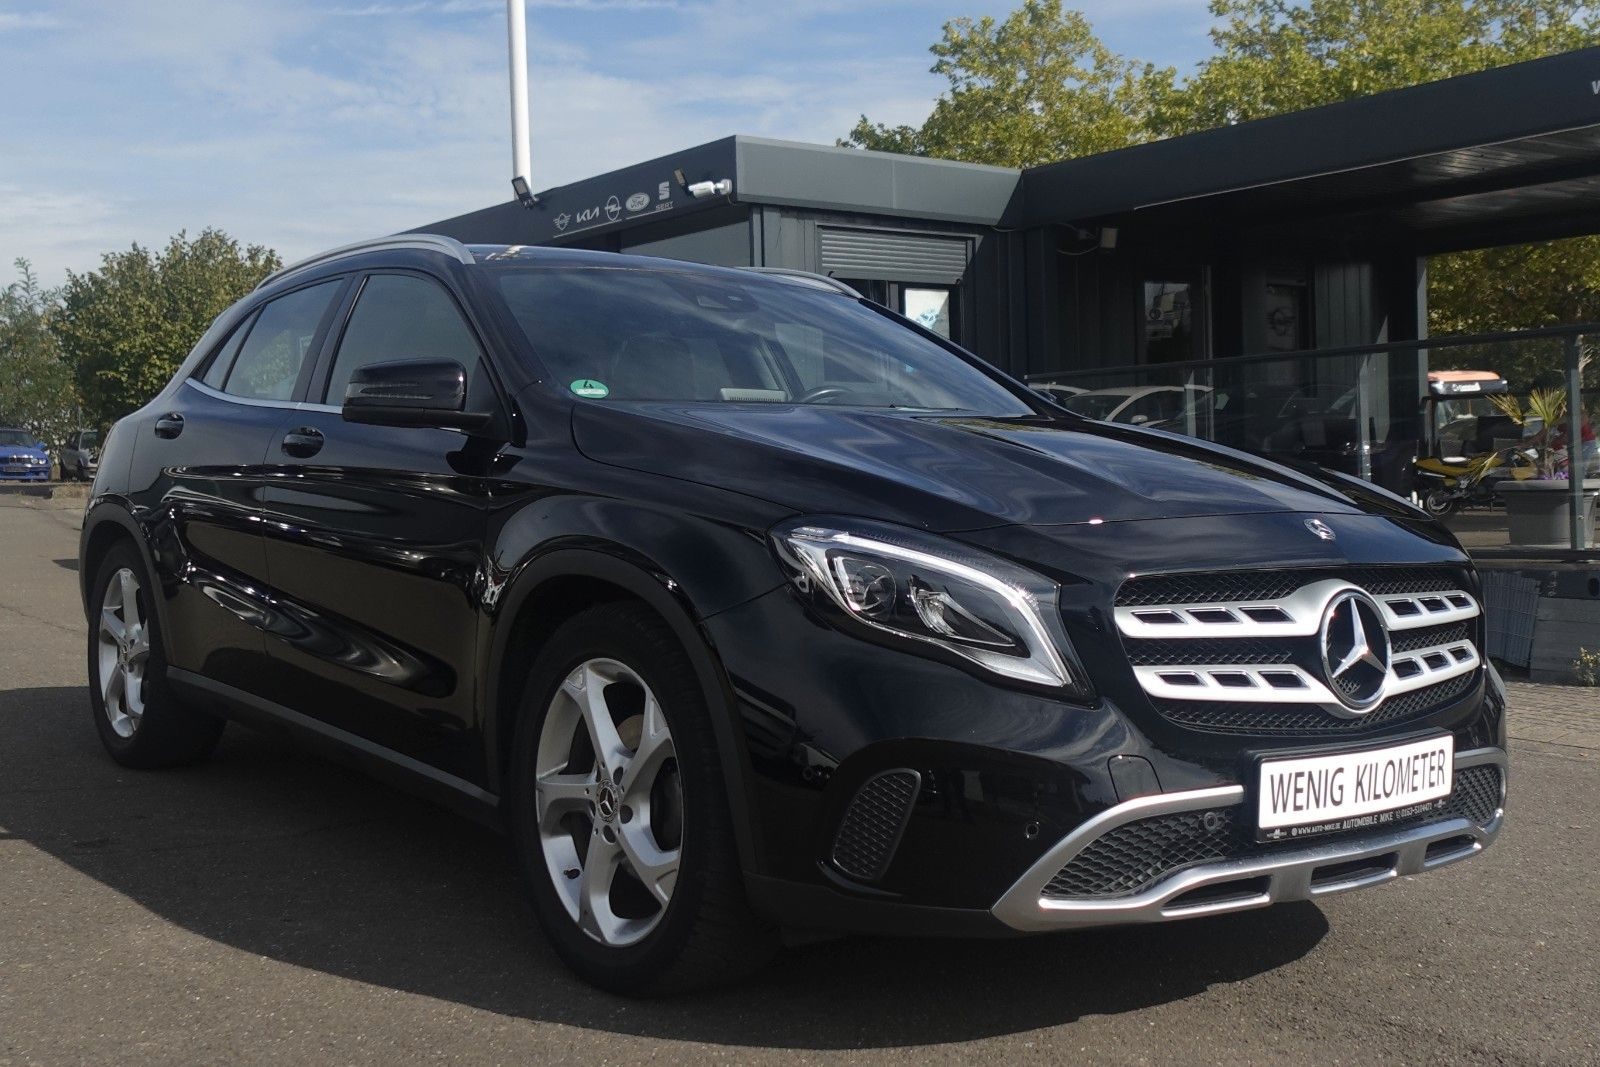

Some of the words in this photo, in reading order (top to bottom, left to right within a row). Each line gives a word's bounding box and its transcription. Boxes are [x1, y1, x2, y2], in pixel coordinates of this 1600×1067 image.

[1269, 767, 1345, 815] WENIG
[1354, 749, 1446, 803] KILOMETER
[1342, 815, 1378, 830] AUTOMOBILE
[1379, 811, 1394, 823] MIKE
